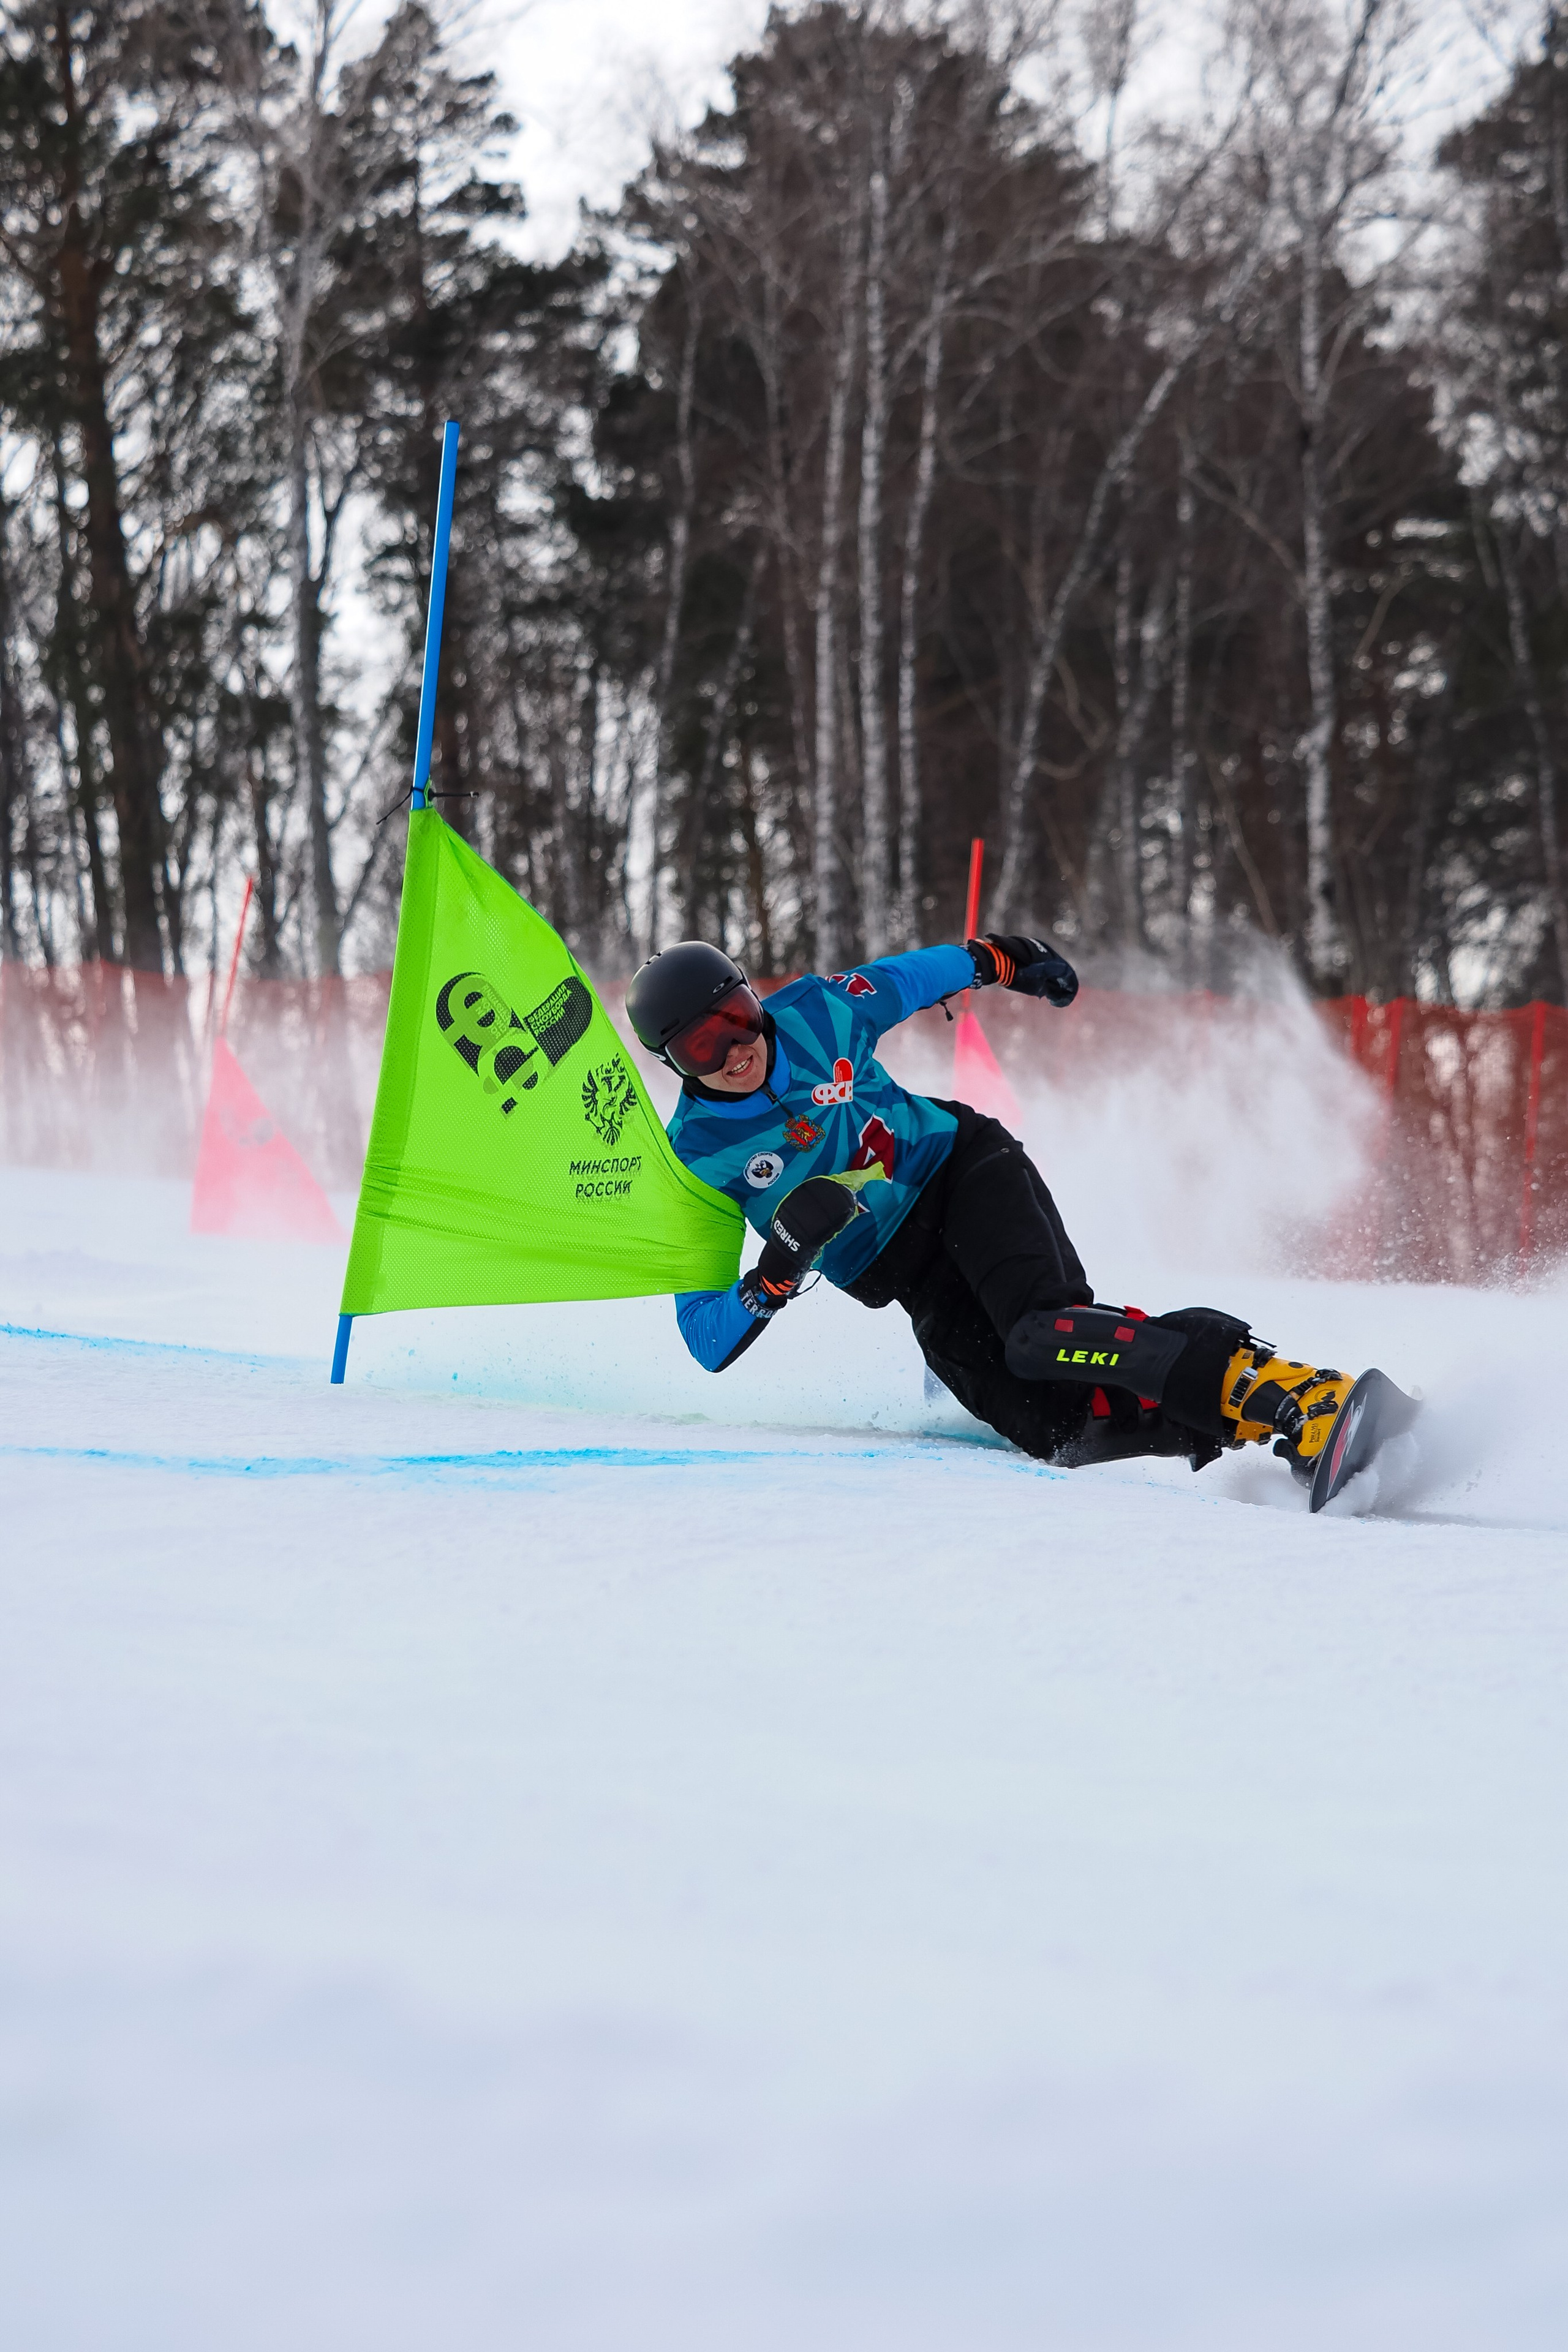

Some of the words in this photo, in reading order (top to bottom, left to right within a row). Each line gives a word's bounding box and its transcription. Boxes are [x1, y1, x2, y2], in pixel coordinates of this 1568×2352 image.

[527, 984, 567, 1023] ФЕДЕРАЦИЯ
[531, 989, 572, 1030] СНОУБОРДА
[534, 1006, 565, 1037] РОССИИ
[569, 1156, 641, 1175] МИНСПОРТ
[576, 1180, 633, 1198] РОССИИ
[774, 1219, 801, 1252] SHRED
[1056, 1349, 1120, 1366] LEKI
